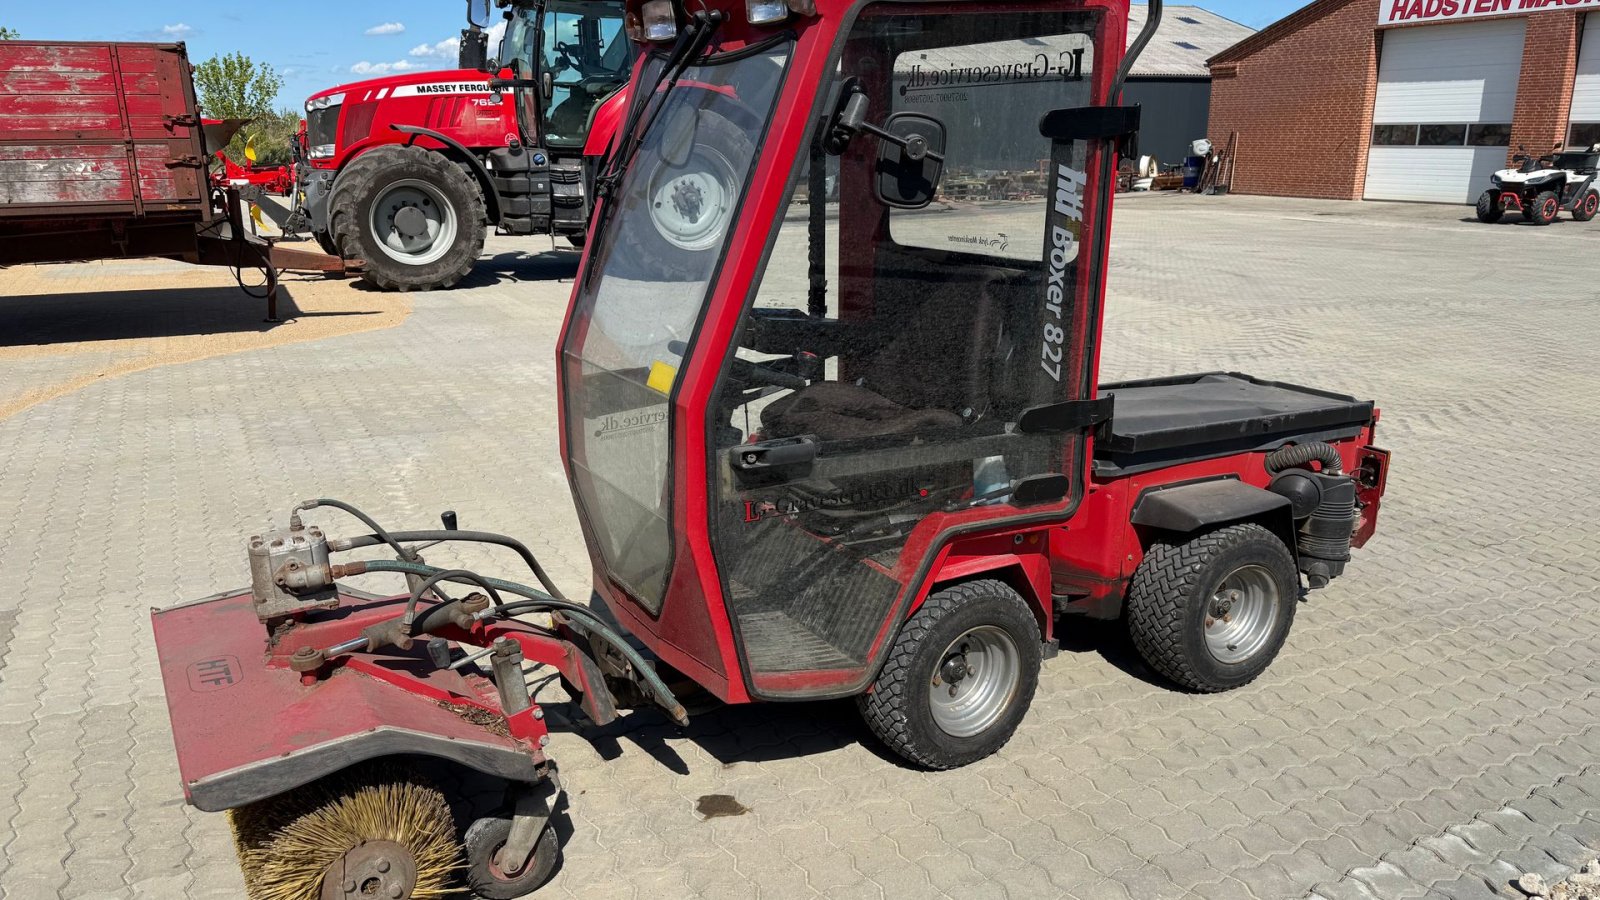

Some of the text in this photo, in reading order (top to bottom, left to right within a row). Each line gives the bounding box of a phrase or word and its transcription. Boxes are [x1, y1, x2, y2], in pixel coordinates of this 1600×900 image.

[1389, 0, 1512, 21] HADSTEN
[417, 83, 510, 93] MASSEY FERGUN
[1046, 225, 1076, 319] Boxer
[1041, 322, 1064, 382] 827
[196, 659, 233, 685] HTF
